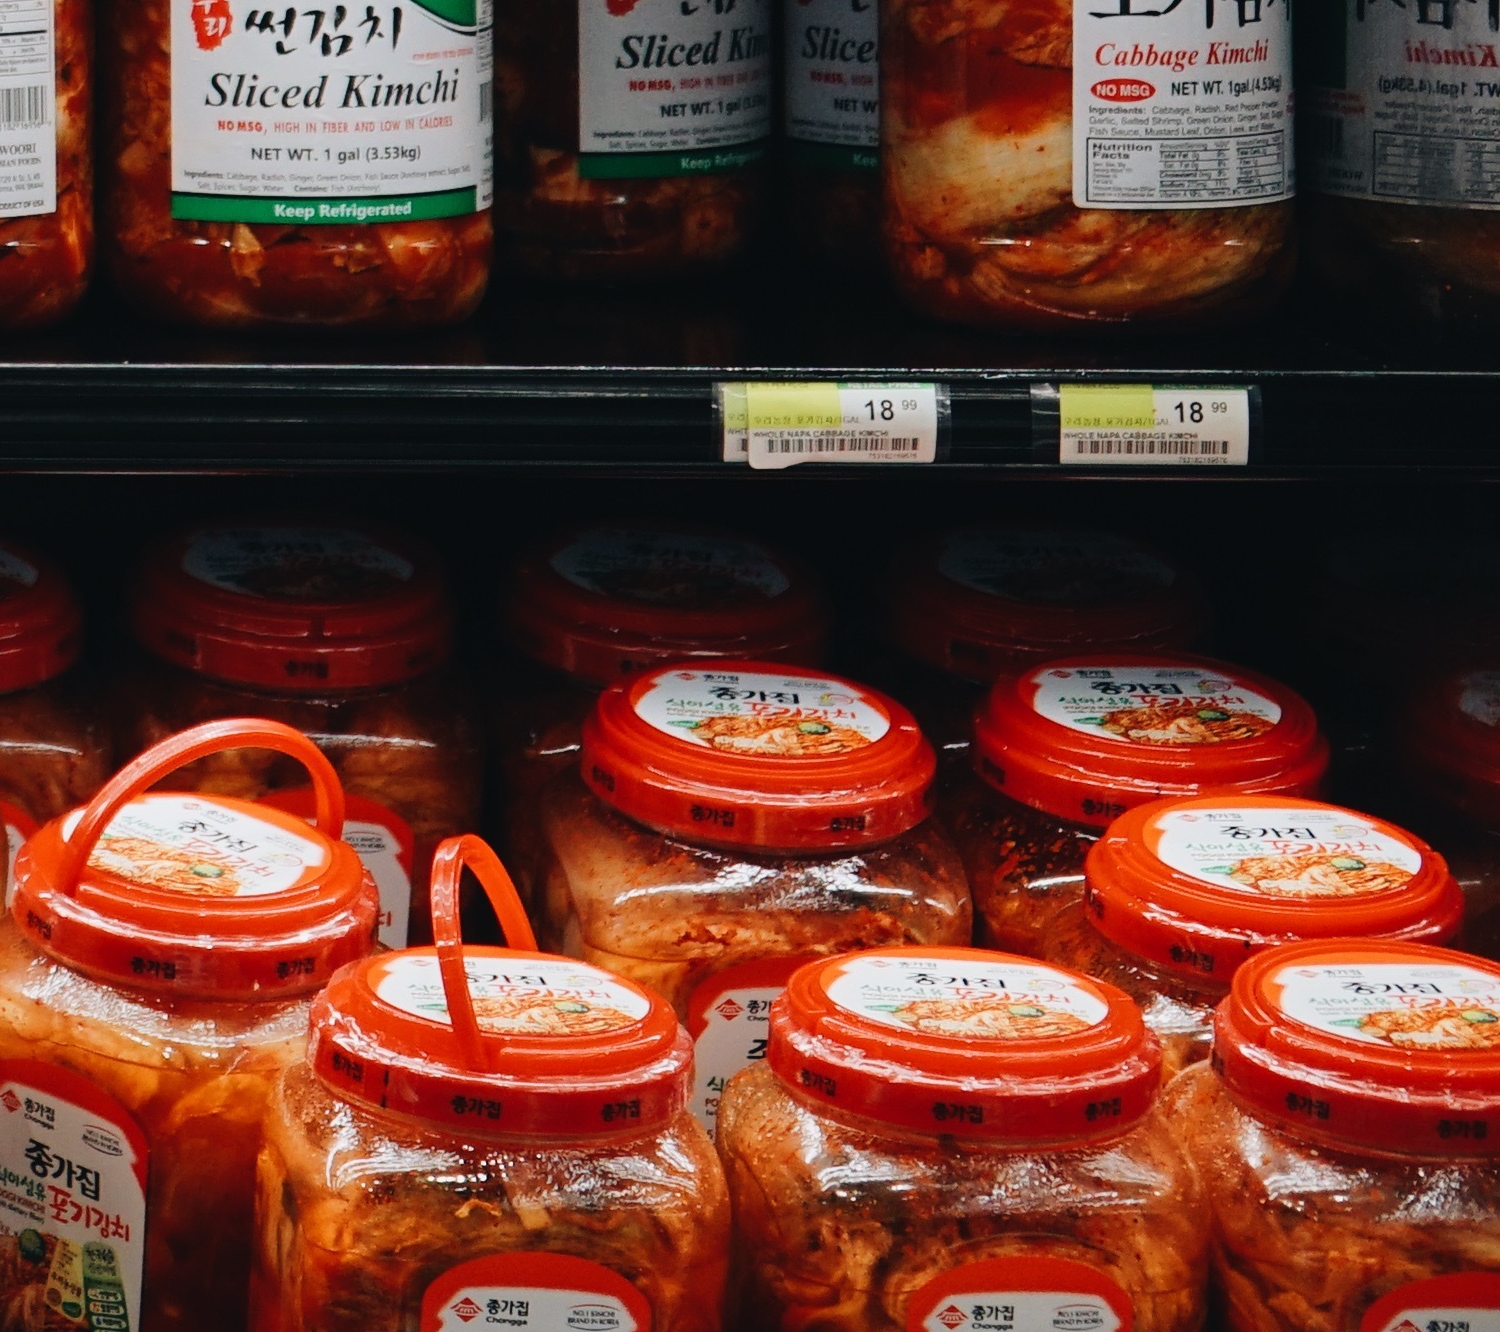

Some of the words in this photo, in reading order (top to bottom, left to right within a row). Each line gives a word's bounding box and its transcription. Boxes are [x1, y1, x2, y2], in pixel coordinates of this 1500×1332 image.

[864, 400, 894, 422] 18
[901, 400, 918, 411] 99
[24, 1137, 101, 1203] 종가집
[47, 1184, 131, 1242] 포기김치
